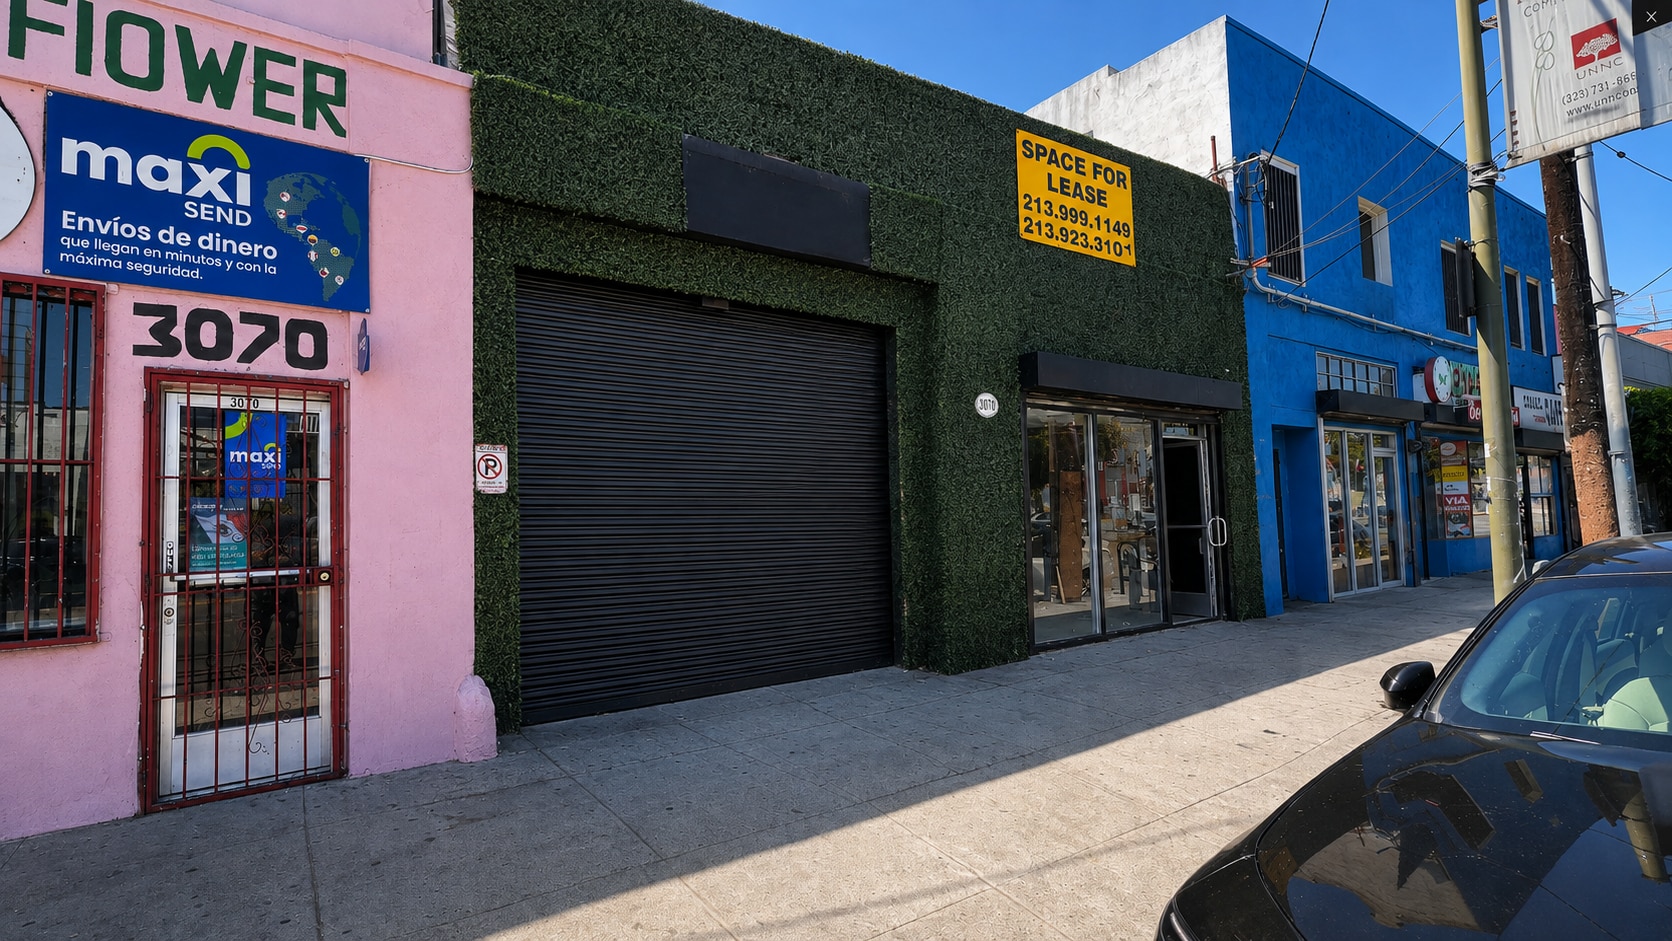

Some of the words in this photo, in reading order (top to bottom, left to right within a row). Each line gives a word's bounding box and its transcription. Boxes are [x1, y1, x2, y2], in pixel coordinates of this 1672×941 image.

[1576, 56, 1624, 80] UNNC
[1562, 88, 1589, 106] (323)
[61, 134, 251, 208] maxi
[1021, 139, 1087, 177] SPACE
[1092, 162, 1128, 190] FOR
[1047, 172, 1108, 208] LEASE
[184, 201, 252, 227] SEND
[1023, 193, 1131, 239] 213.999.1149
[62, 210, 151, 241] Envíos
[157, 225, 192, 247] de
[197, 232, 278, 260] dinero
[1023, 216, 1132, 258] 213.923.3101
[59, 252, 122, 269] máxima
[126, 261, 203, 280] seguridad.
[60, 236, 90, 249] que
[94, 238, 140, 256] llegan
[143, 248, 162, 259] en
[165, 251, 222, 267] minutos
[225, 259, 234, 272] y
[236, 261, 261, 273] con
[264, 262, 277, 275] la
[133, 302, 329, 370] 3070
[229, 441, 281, 464] maxi
